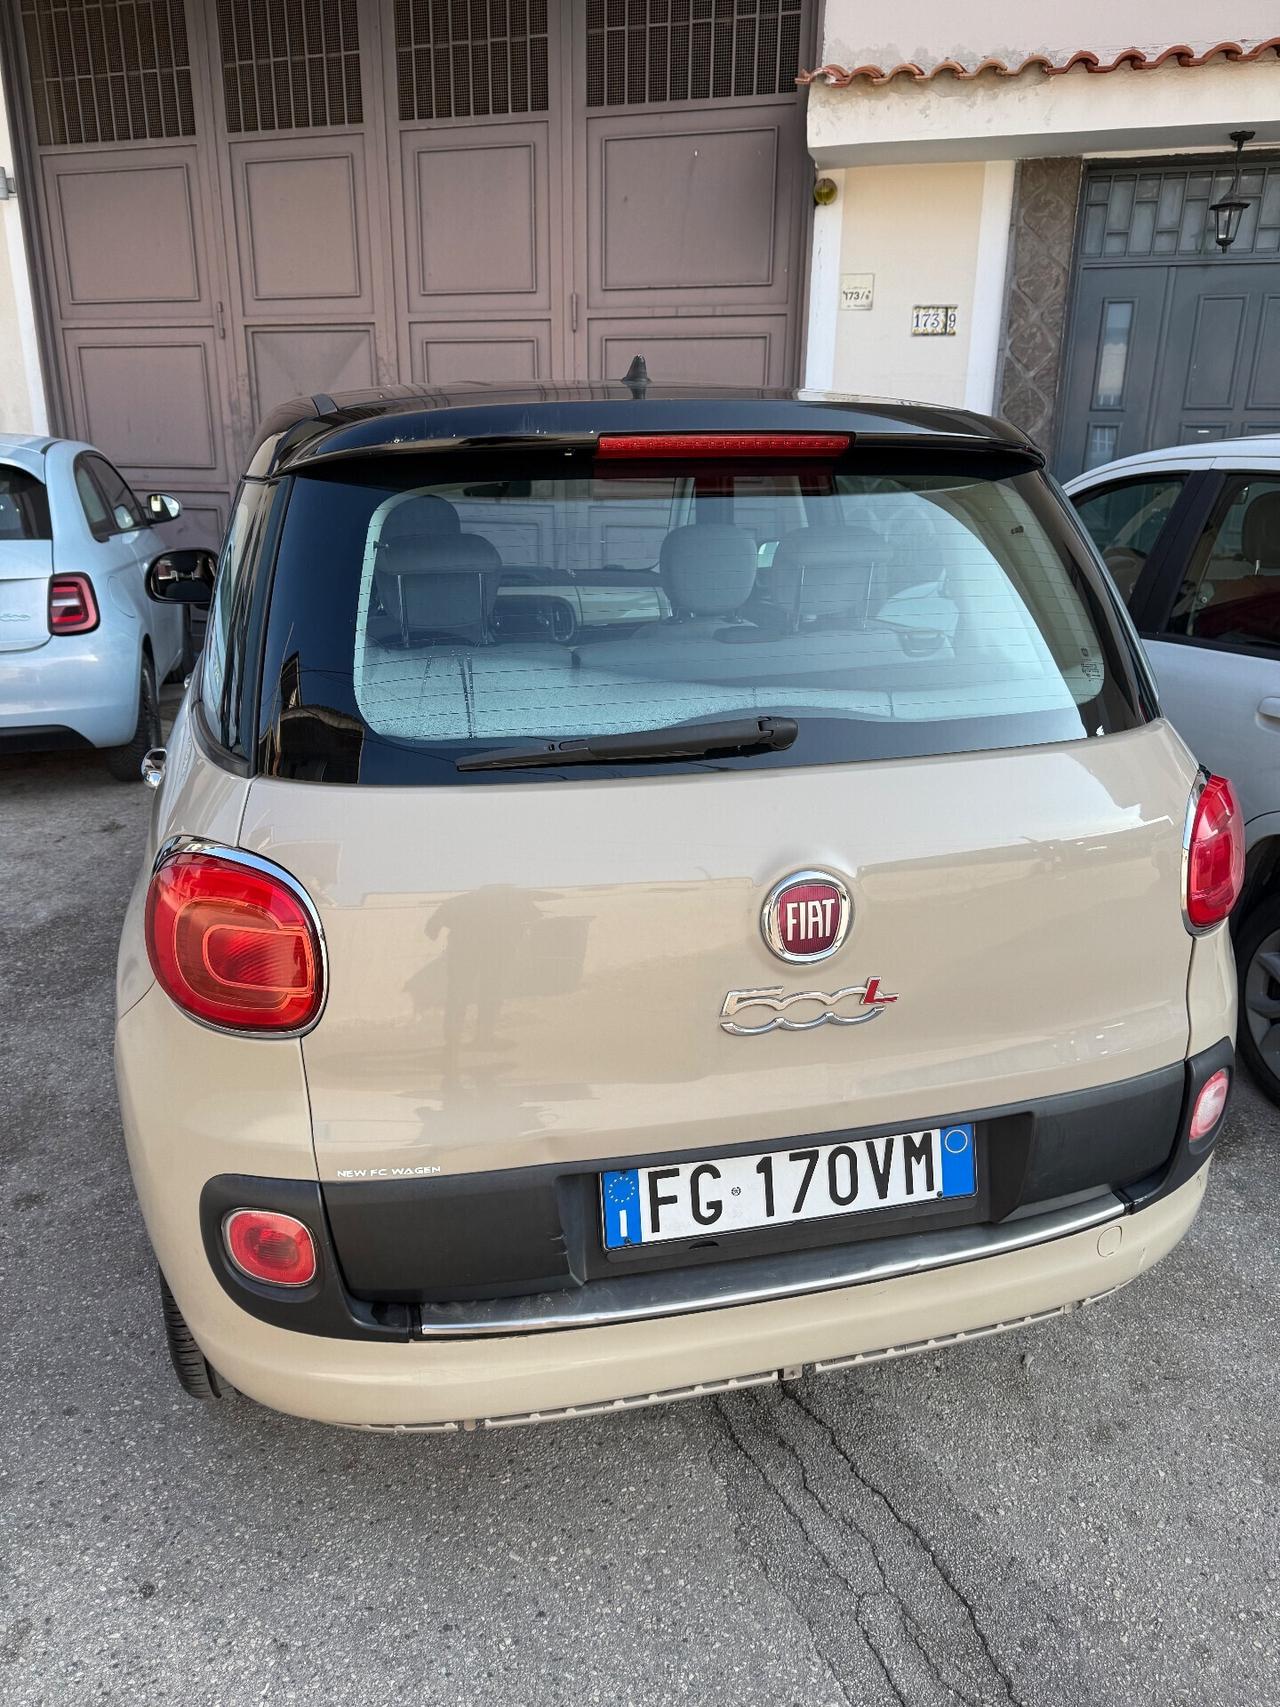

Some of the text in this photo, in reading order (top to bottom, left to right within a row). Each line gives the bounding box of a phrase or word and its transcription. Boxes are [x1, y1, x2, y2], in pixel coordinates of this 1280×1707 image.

[914, 313, 957, 329] 173 9
[786, 898, 836, 942] FIAT
[336, 1165, 441, 1178] NEW FC WAGEN
[647, 1132, 935, 1234] FG 170VM
